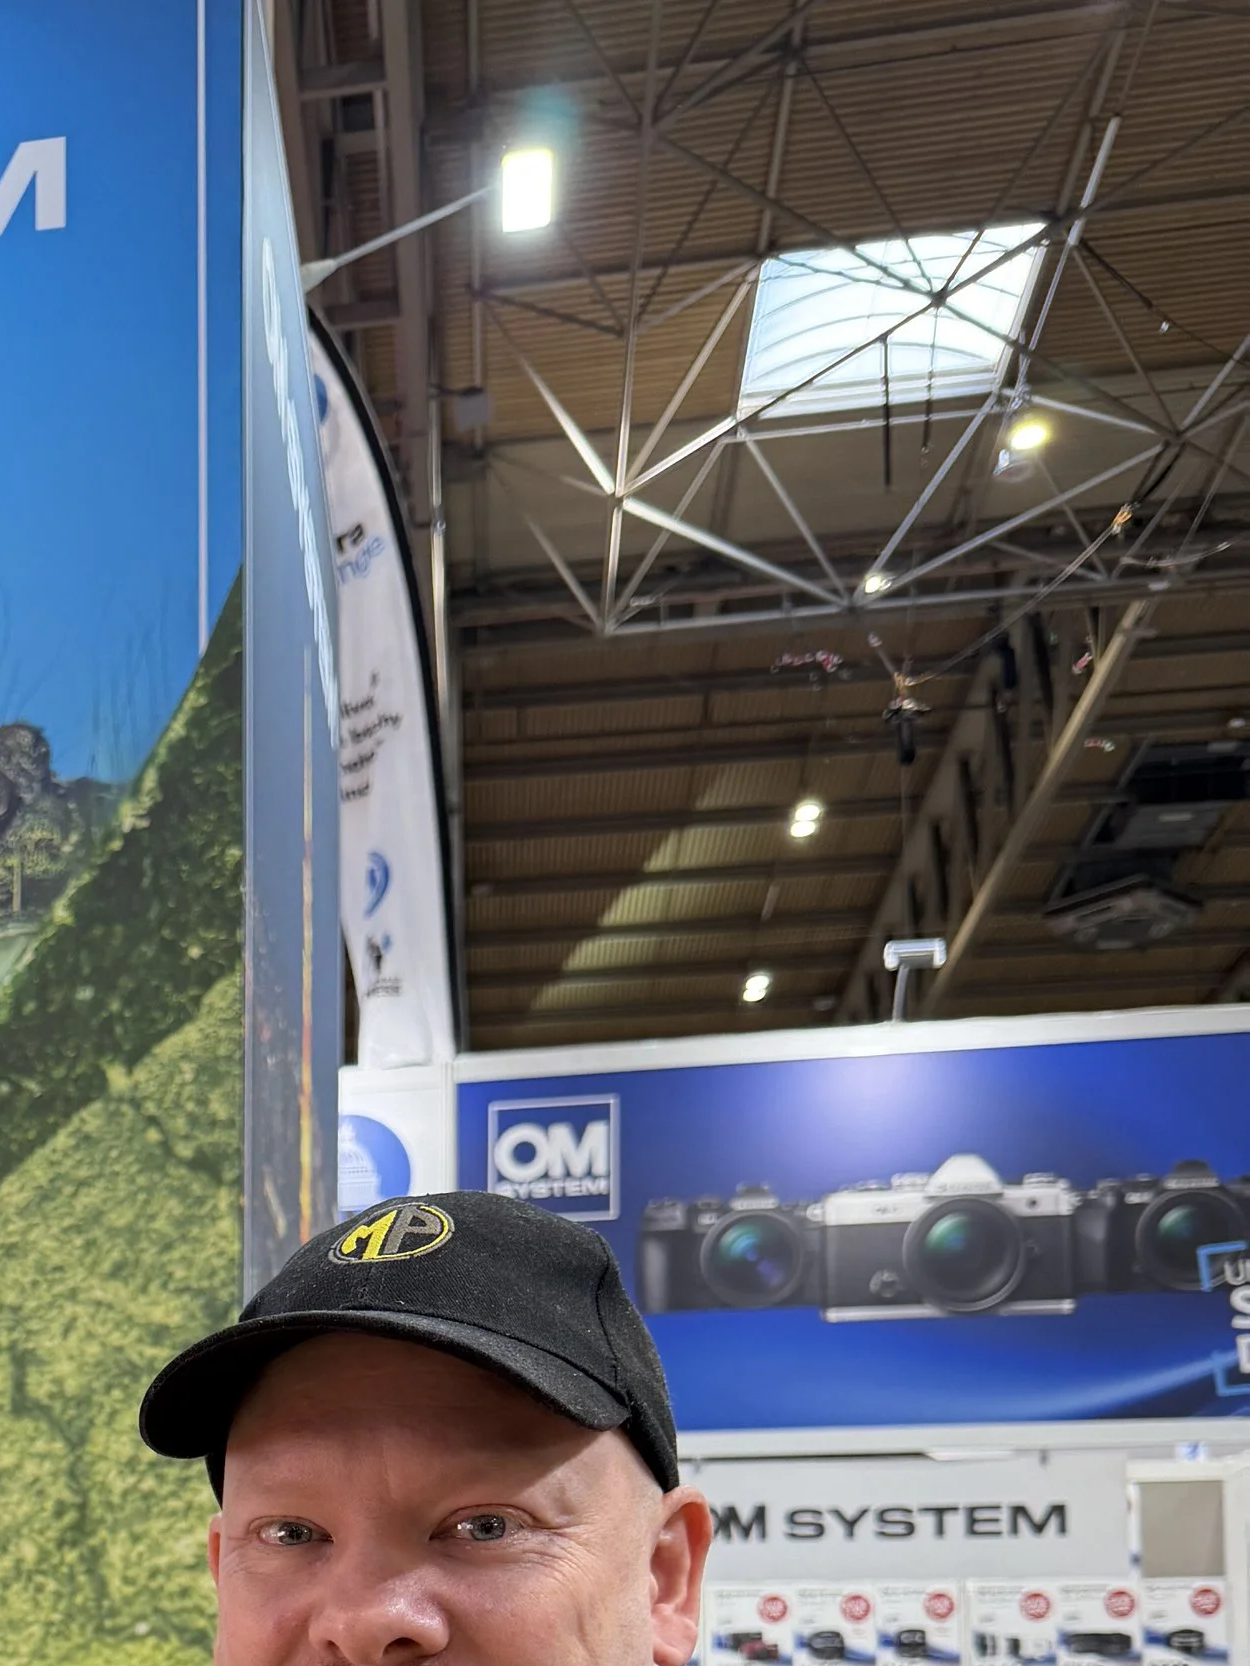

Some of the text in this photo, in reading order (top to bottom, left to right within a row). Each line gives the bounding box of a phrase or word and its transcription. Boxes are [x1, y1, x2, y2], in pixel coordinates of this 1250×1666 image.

[495, 1120, 609, 1183] OM
[495, 1176, 610, 1199] SYSTEM
[786, 1503, 1068, 1541] SYSTEM
